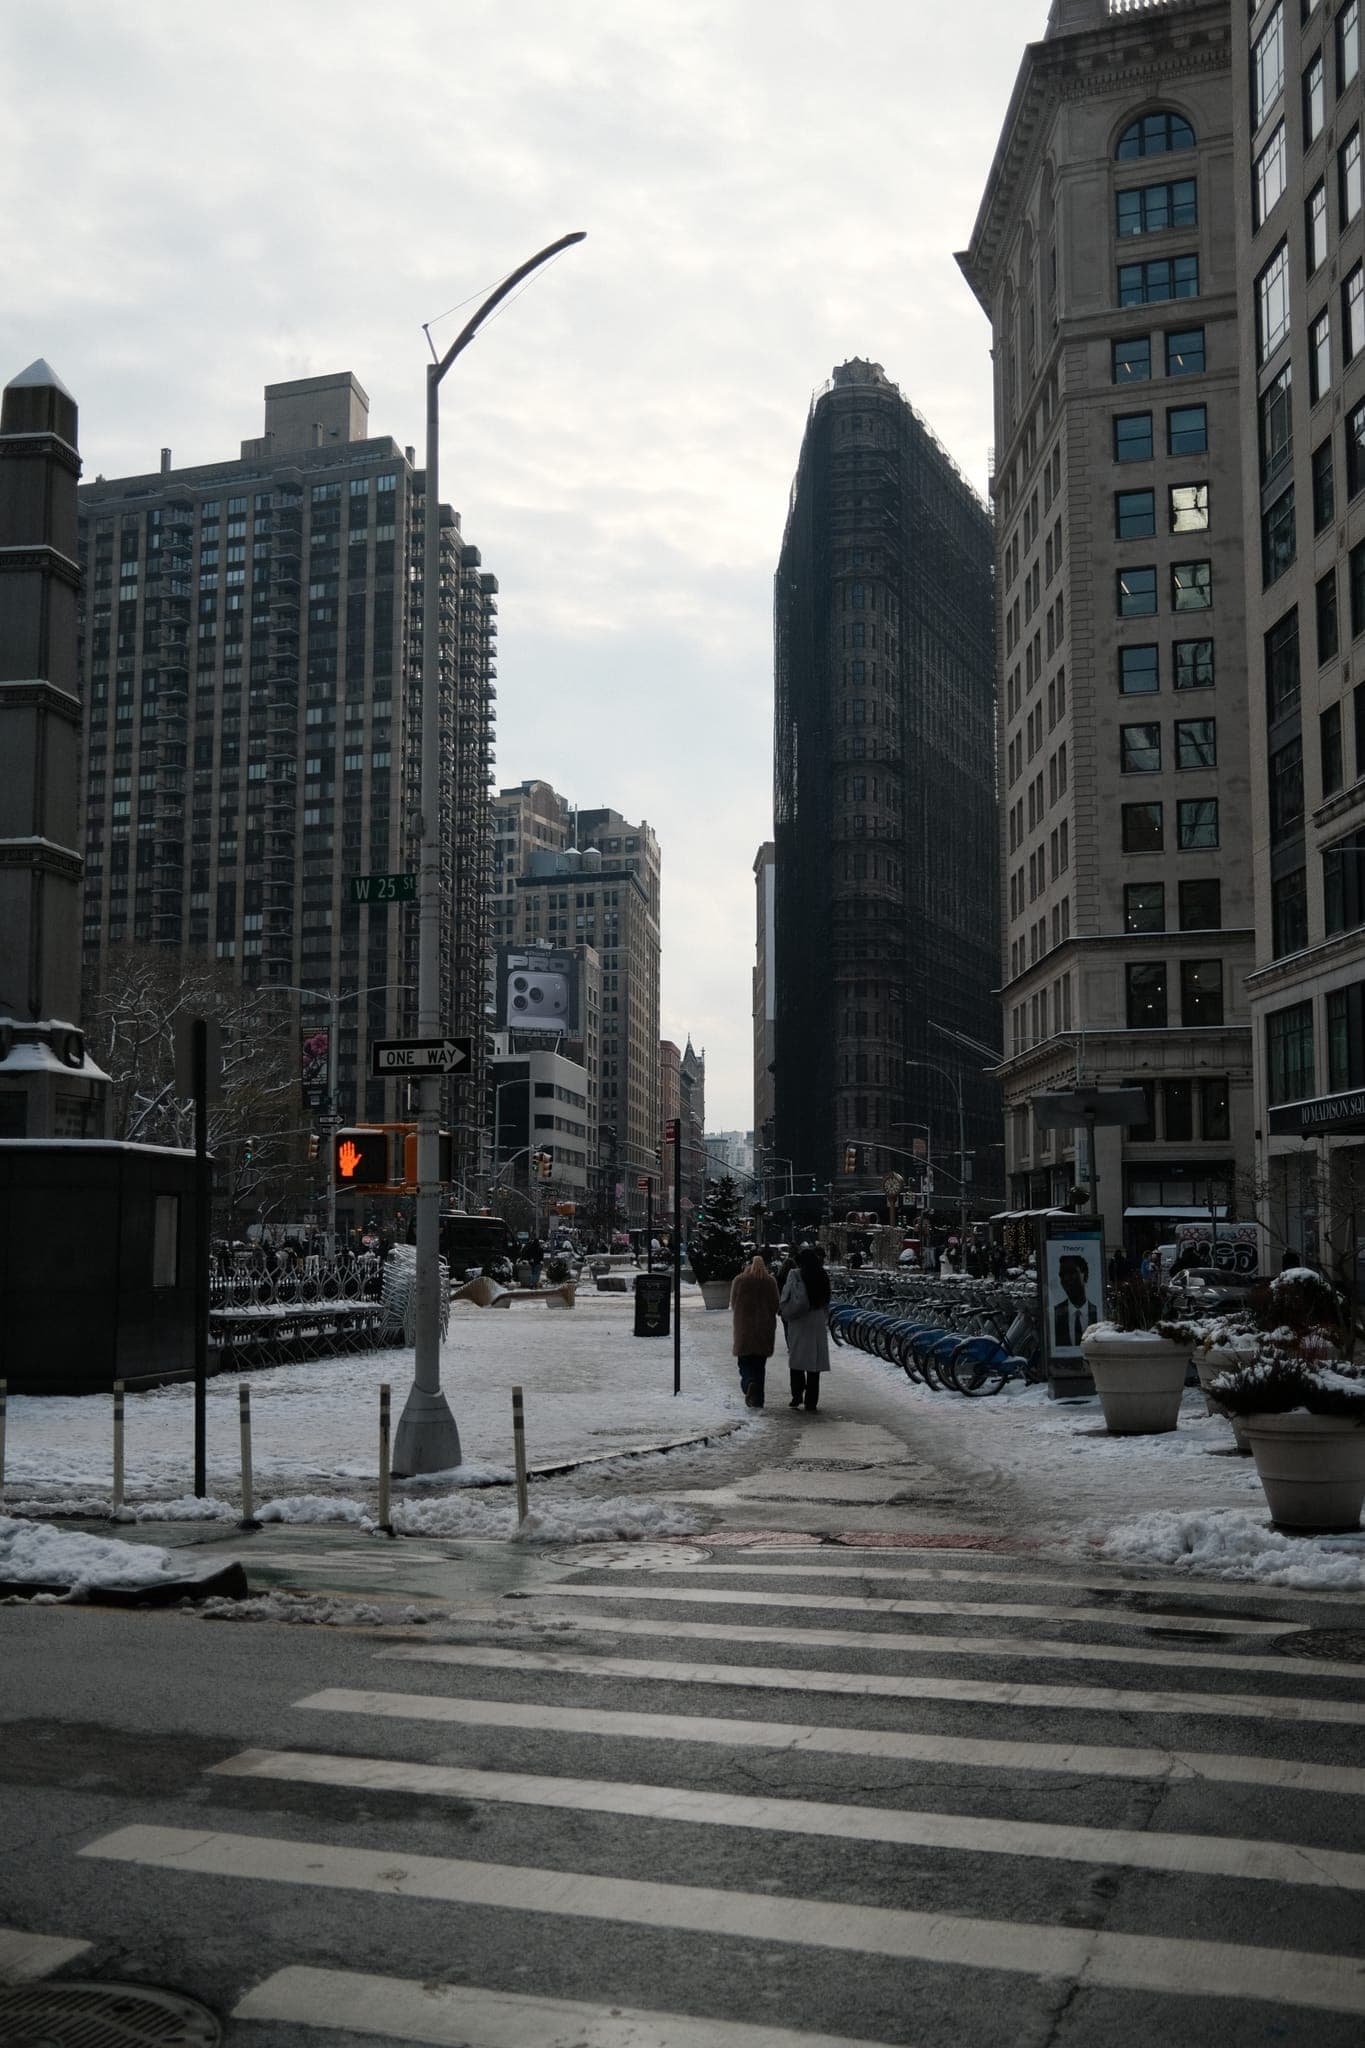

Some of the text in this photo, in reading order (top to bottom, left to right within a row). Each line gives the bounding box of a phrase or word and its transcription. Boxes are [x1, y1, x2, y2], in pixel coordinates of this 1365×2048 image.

[356, 880, 370, 899] W
[378, 878, 395, 898] 25
[507, 954, 569, 971] PRO
[387, 1049, 456, 1065] ONE WAY
[1301, 1107, 1310, 1124] 10
[1311, 1097, 1349, 1121] MADISON
